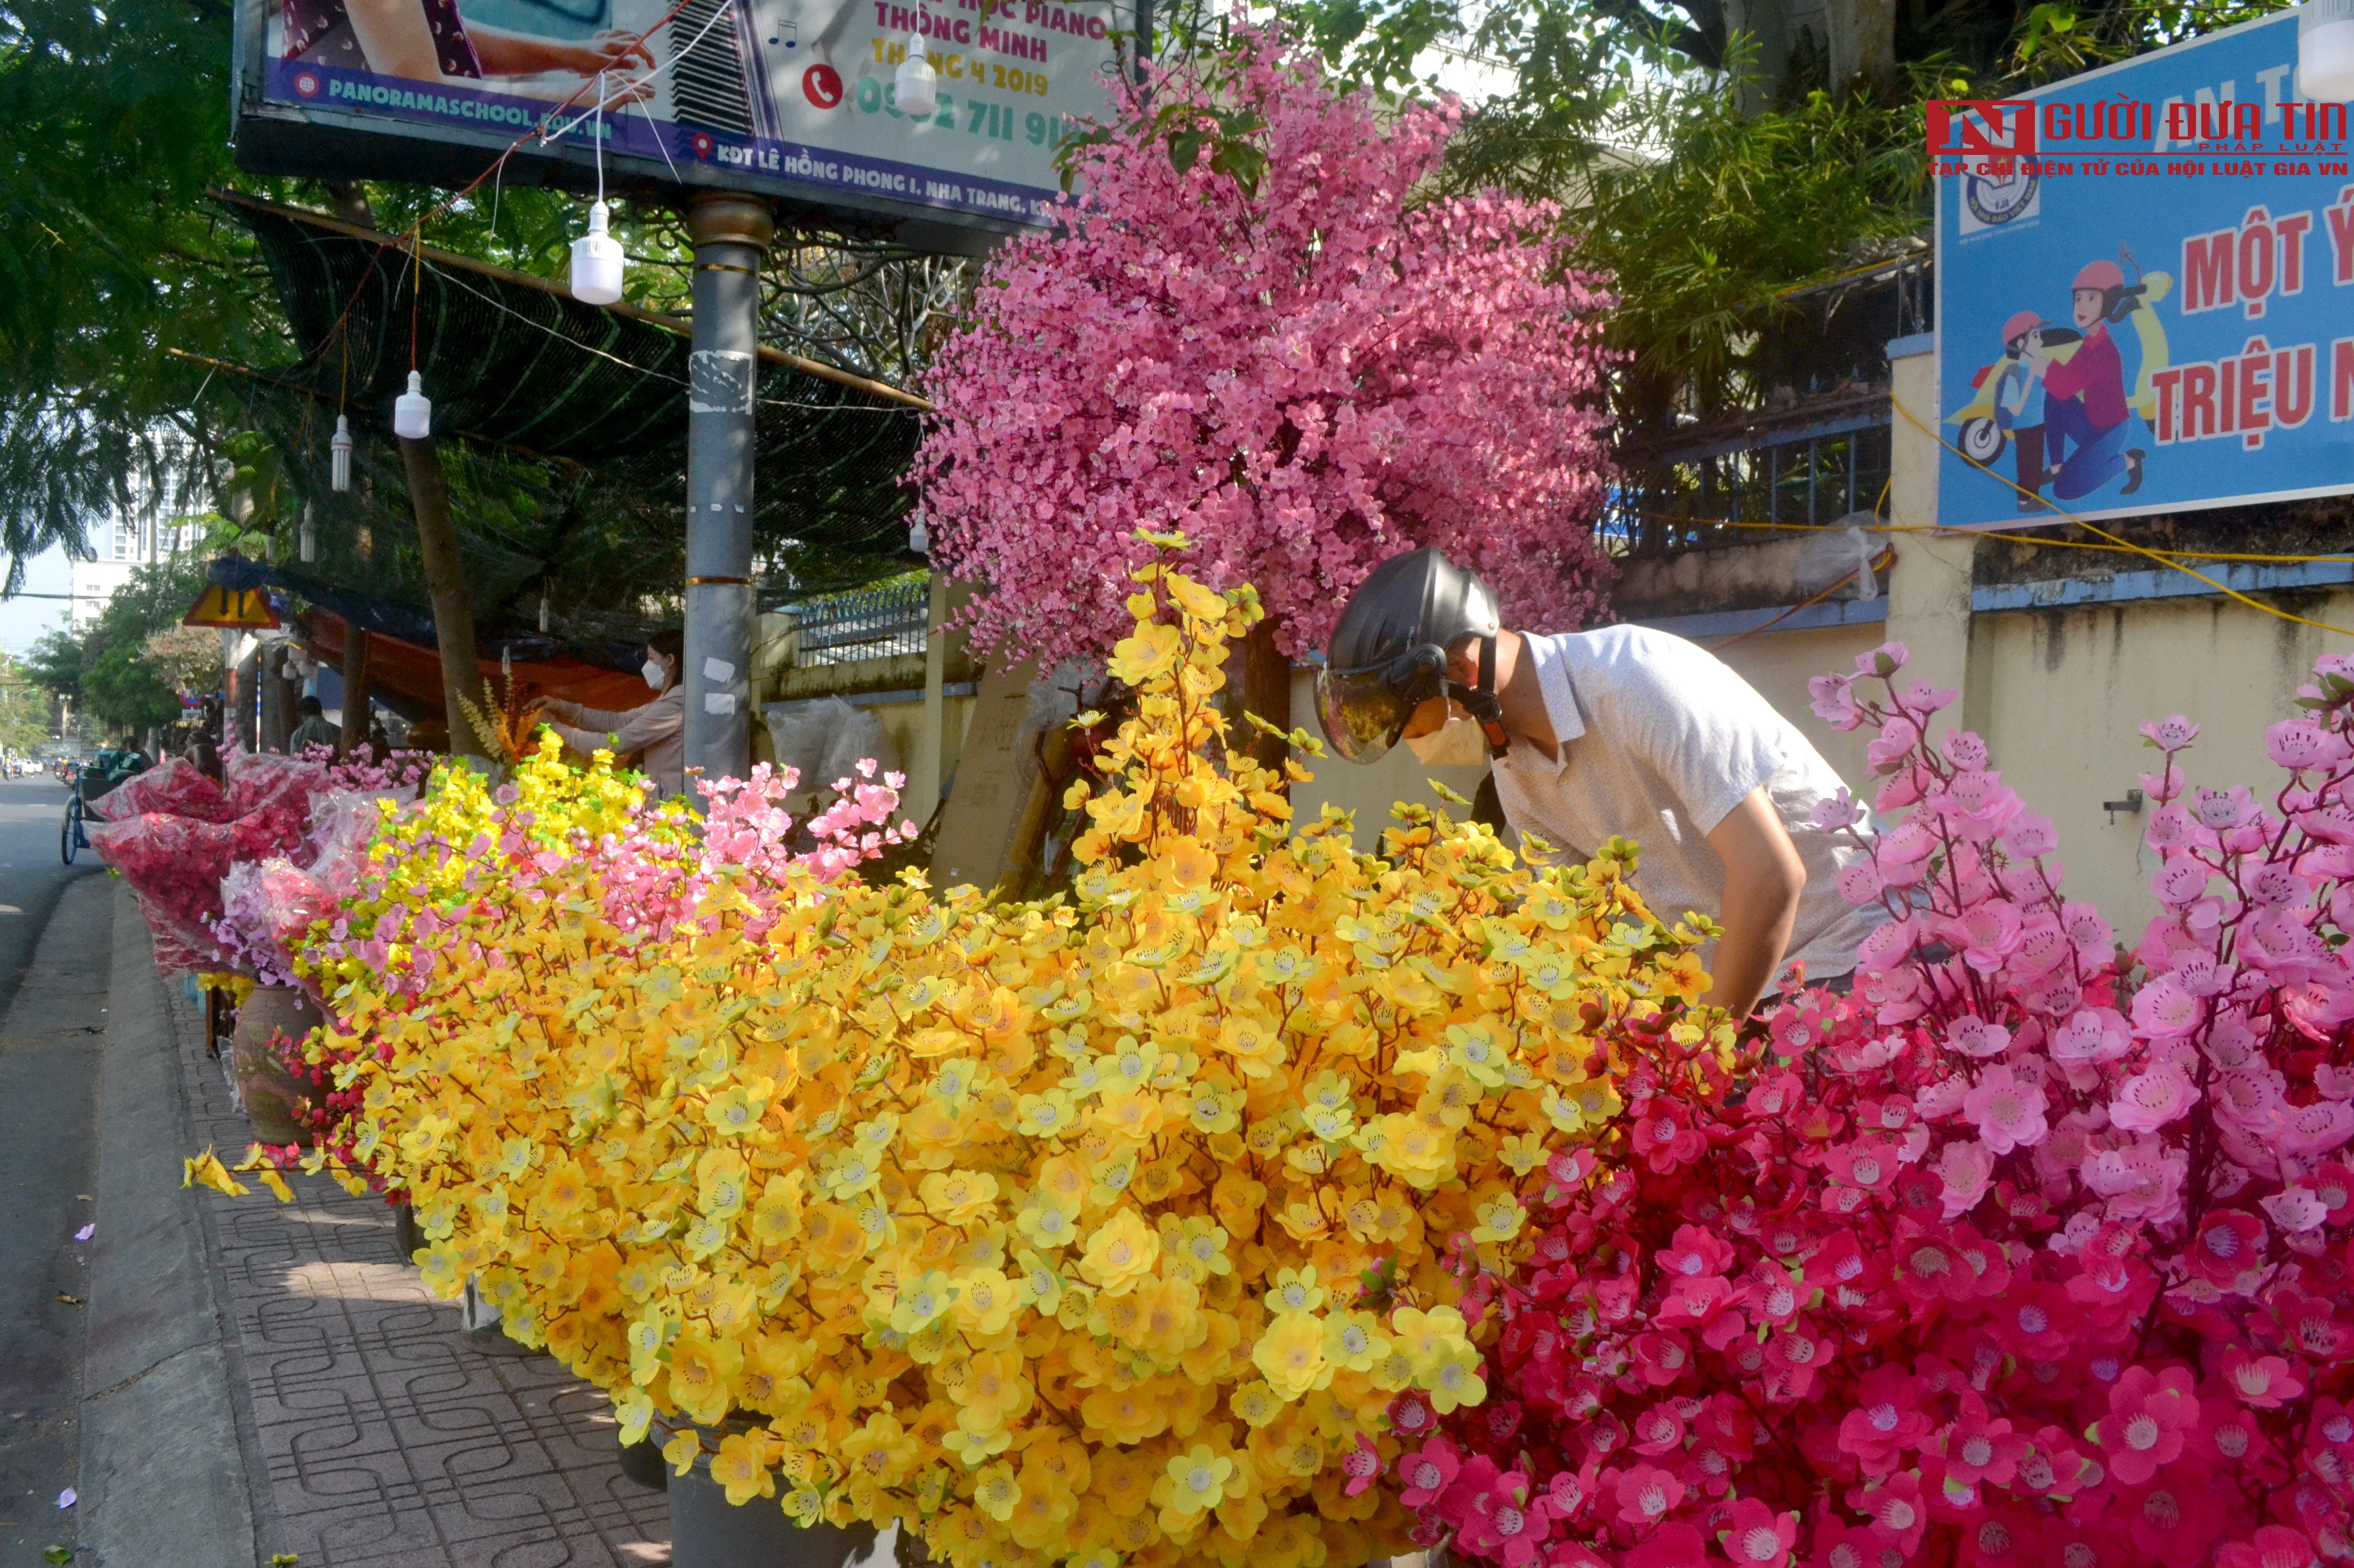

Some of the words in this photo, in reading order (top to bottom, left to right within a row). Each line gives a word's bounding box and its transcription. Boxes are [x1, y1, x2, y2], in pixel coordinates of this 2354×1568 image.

[874, 2, 971, 44] THÔNG
[979, 26, 1047, 62] MINH
[1025, 2, 1107, 40] PIANO
[871, 38, 962, 78] THNG
[993, 65, 1048, 97] 2019
[717, 145, 753, 166] KĐT
[758, 148, 780, 170] LÊ
[784, 148, 838, 180] HỒNG
[842, 166, 905, 191] PHONG
[926, 180, 962, 202] NHA
[2183, 206, 2311, 317] MỘT
[2151, 337, 2314, 448] TRIỆU
